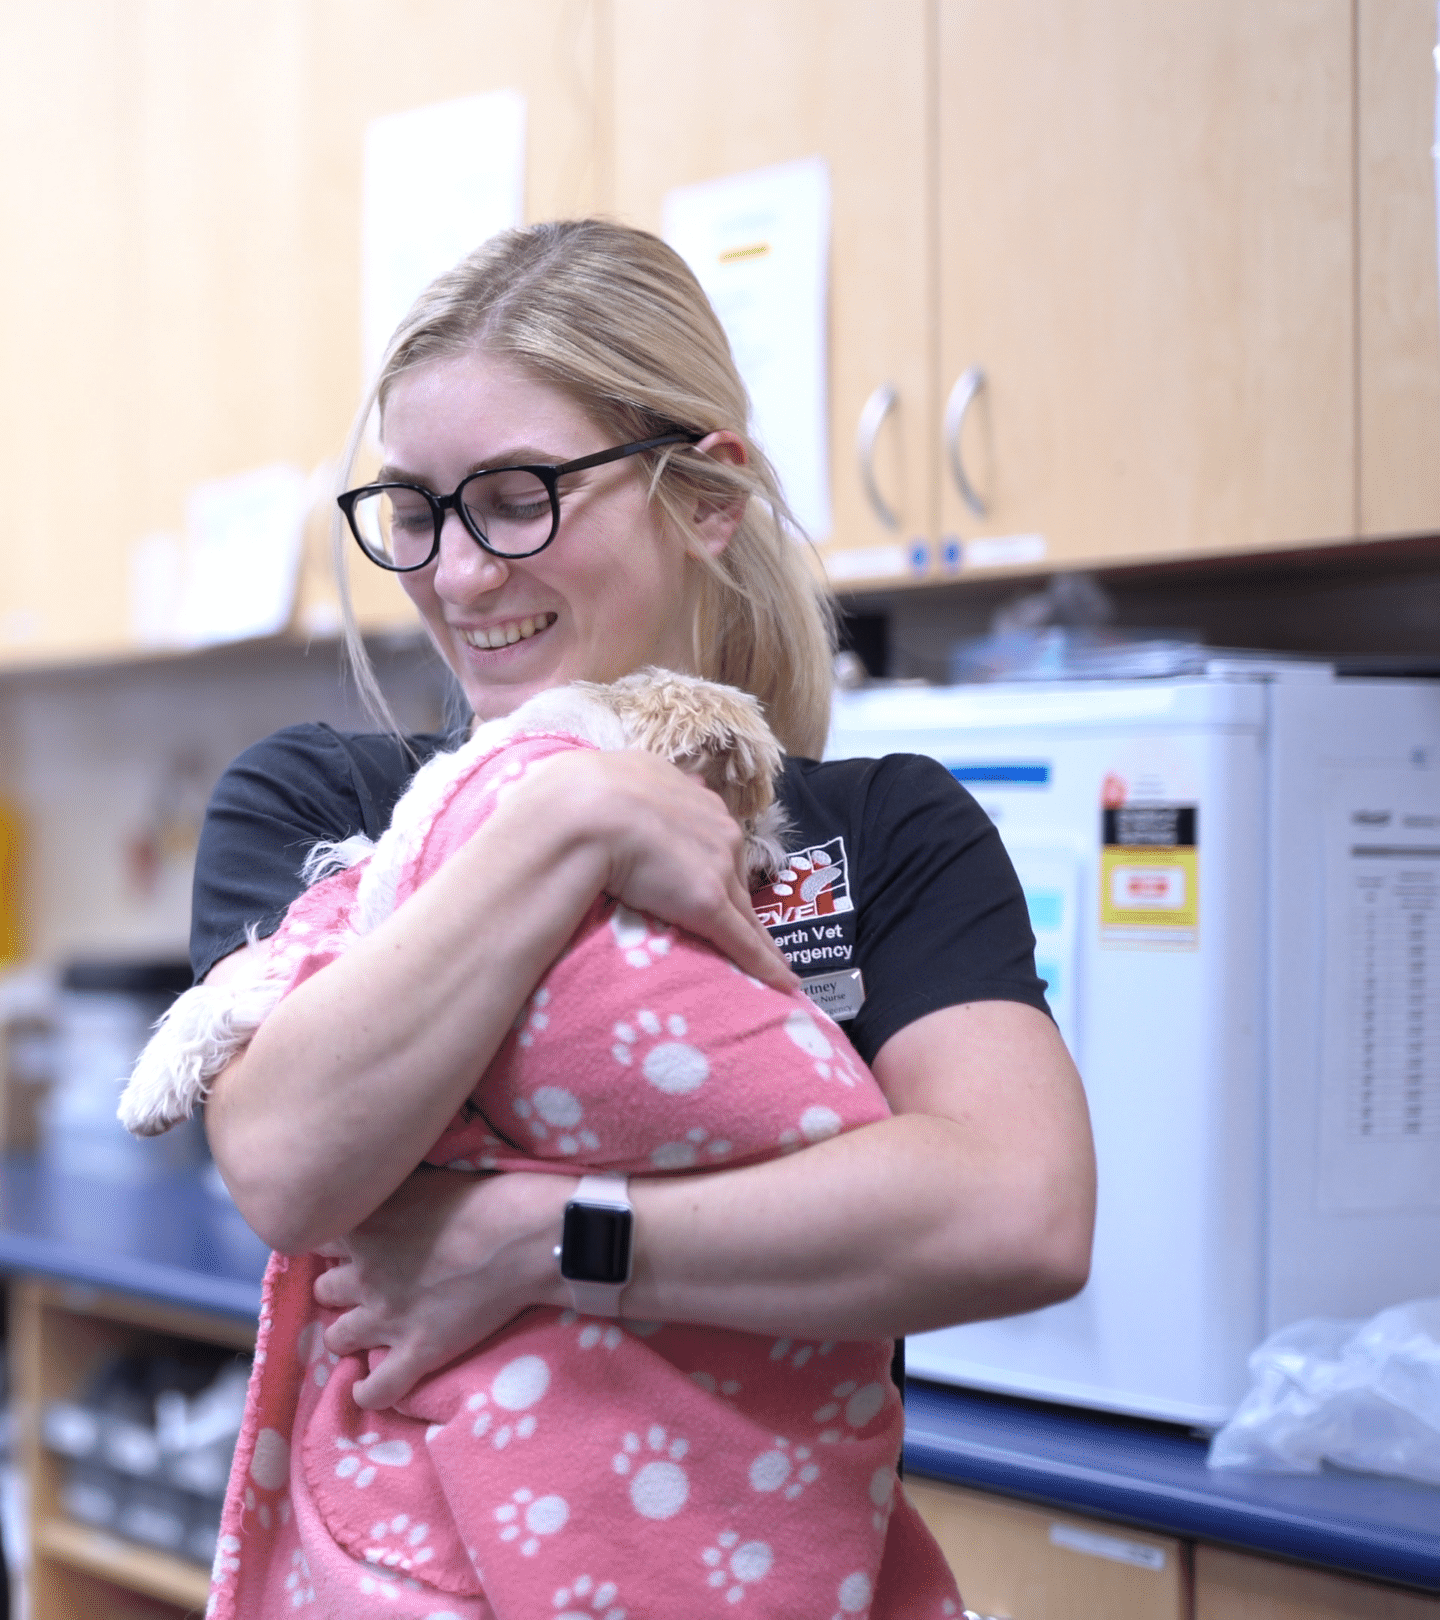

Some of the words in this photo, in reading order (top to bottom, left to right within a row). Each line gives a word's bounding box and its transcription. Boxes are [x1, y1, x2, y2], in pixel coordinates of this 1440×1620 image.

[774, 930, 808, 947] erth
[812, 924, 843, 941] Vet
[784, 944, 853, 964] ergency
[802, 981, 837, 995] rtney
[821, 993, 846, 1003] Nurse
